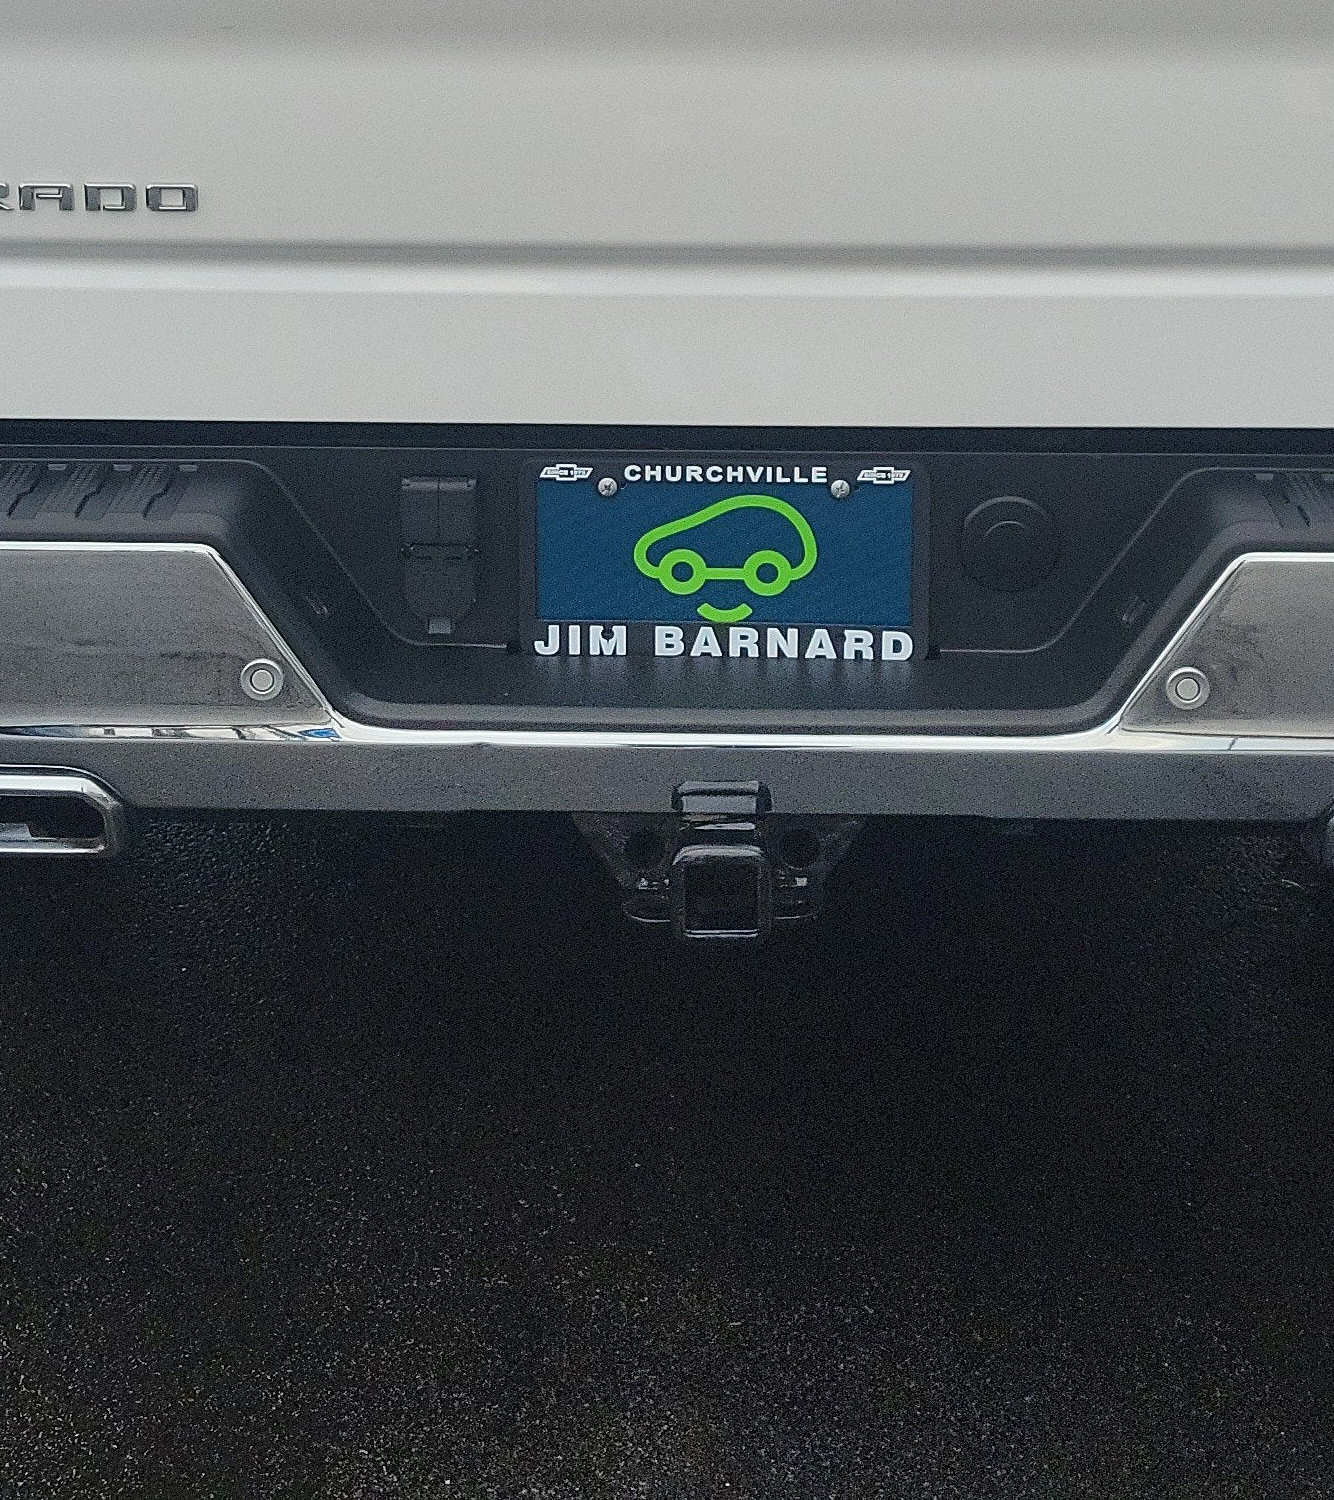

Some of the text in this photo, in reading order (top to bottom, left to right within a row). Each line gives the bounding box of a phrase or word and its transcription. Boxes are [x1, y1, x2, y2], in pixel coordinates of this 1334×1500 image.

[623, 463, 828, 484] CHURCHVILLE
[534, 625, 914, 661] JIM BARNARD
